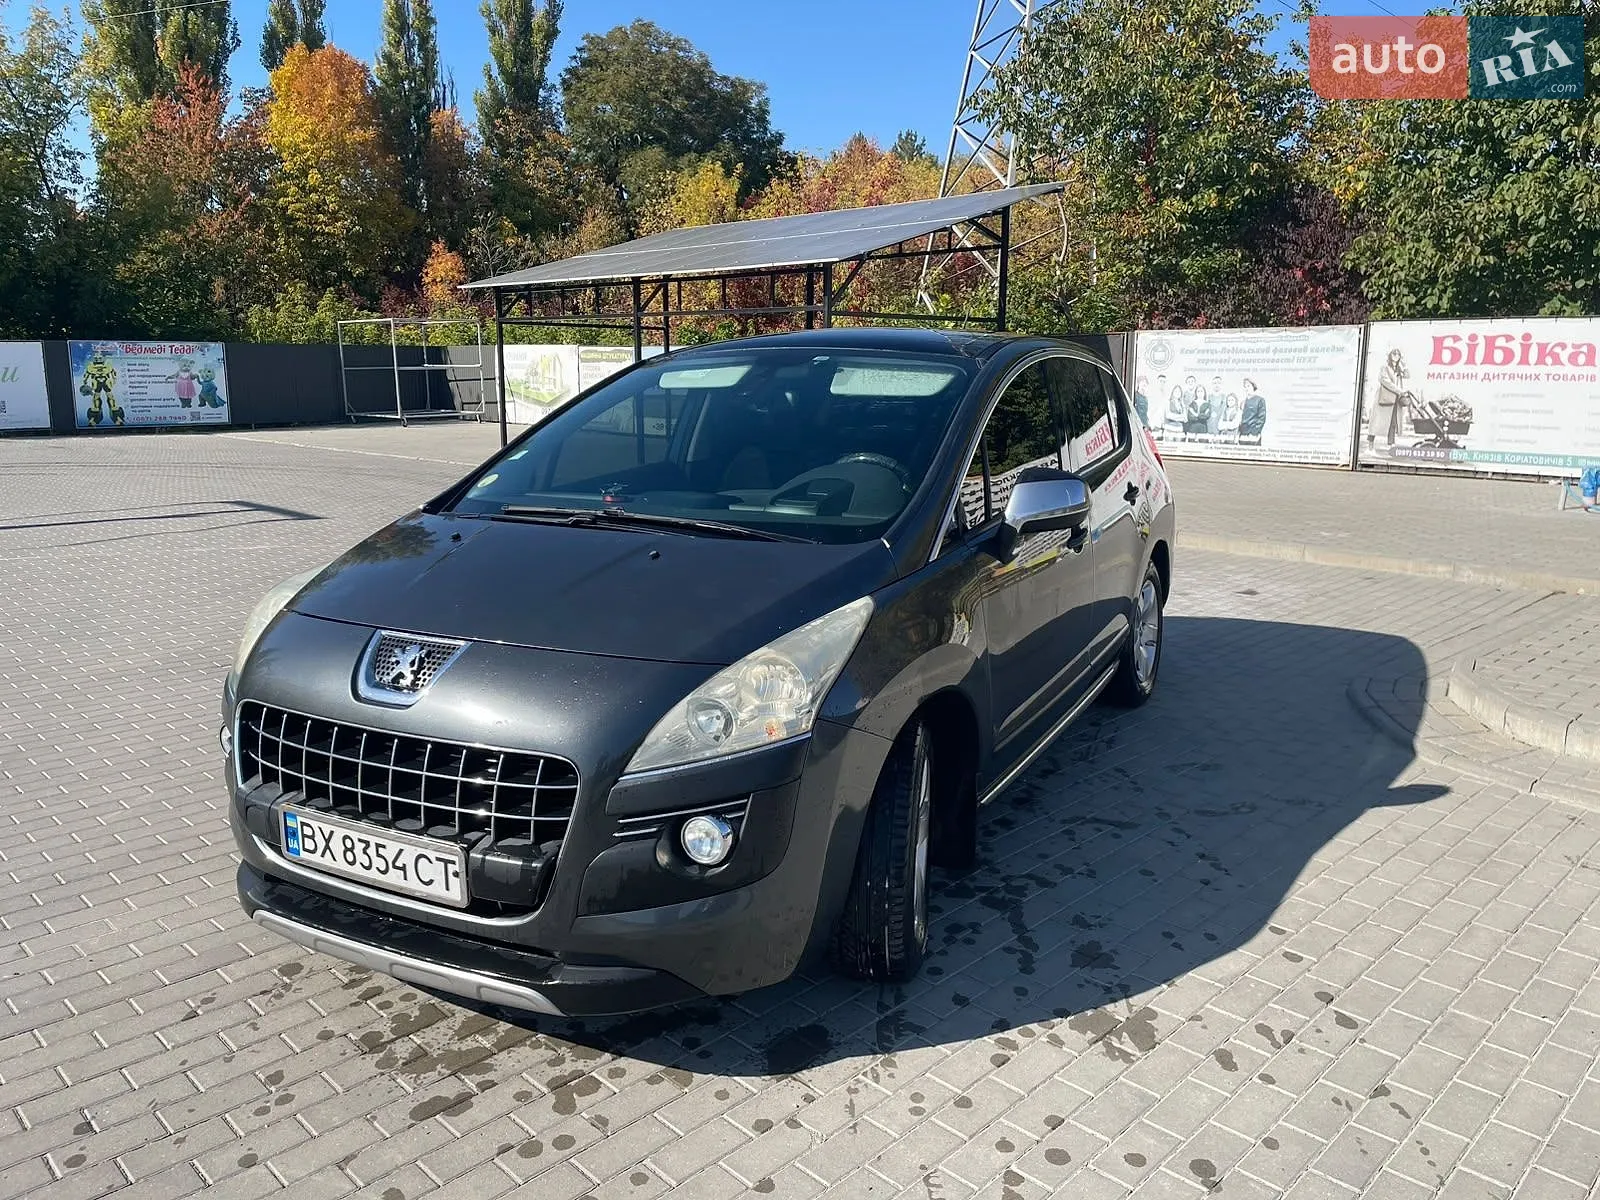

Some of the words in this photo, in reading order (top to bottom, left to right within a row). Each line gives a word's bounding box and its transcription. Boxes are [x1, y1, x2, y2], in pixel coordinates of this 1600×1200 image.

[1428, 332, 1598, 368] БіБіка
[1427, 372, 1479, 381] МАГАЗИН
[1481, 372, 1541, 383] ДИТЯЧИХ
[1546, 373, 1597, 383] ТОВАРІВ
[287, 837, 299, 850] UA
[300, 821, 337, 862] BX
[341, 834, 408, 881] 8354
[414, 853, 456, 891] CT
